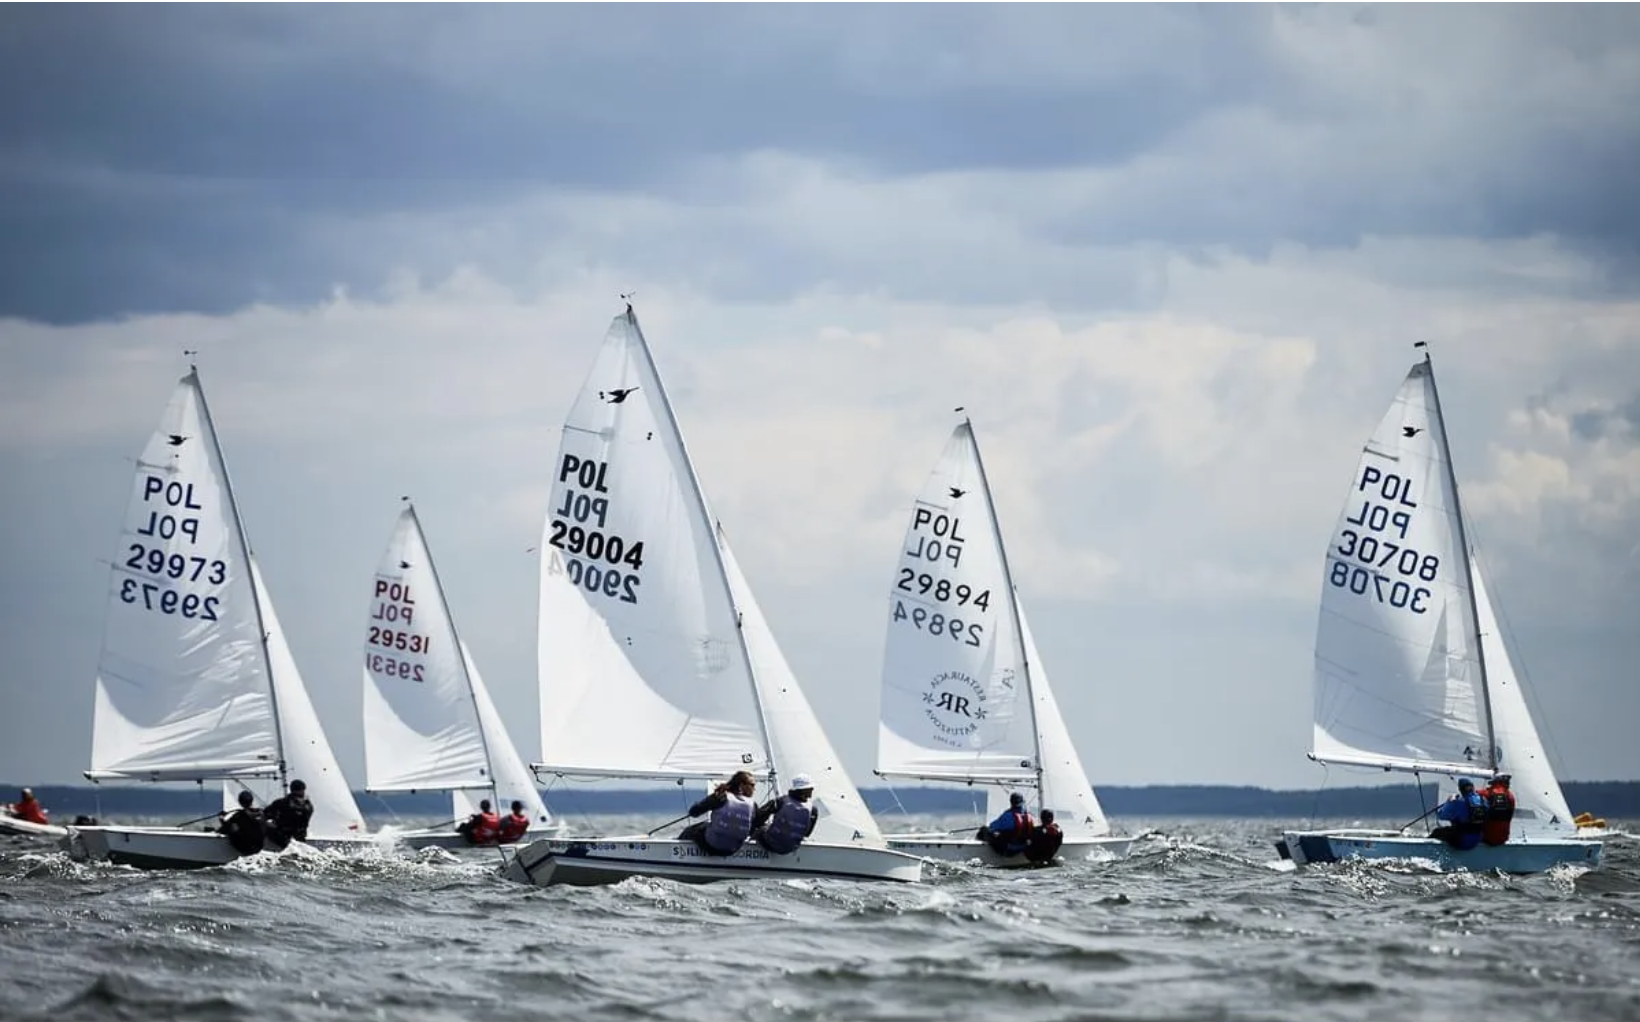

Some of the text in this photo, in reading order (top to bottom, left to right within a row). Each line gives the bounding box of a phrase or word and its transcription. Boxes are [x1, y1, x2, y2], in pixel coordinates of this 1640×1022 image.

[144, 476, 201, 510] POL
[560, 454, 608, 493] POL
[1359, 466, 1417, 508] POL
[549, 520, 644, 570] 29004
[913, 508, 965, 543] POL
[126, 543, 226, 585] 29973
[1338, 530, 1439, 581] 30708
[375, 580, 415, 605] POL
[898, 568, 990, 613] 29894
[369, 626, 430, 654] 29531
